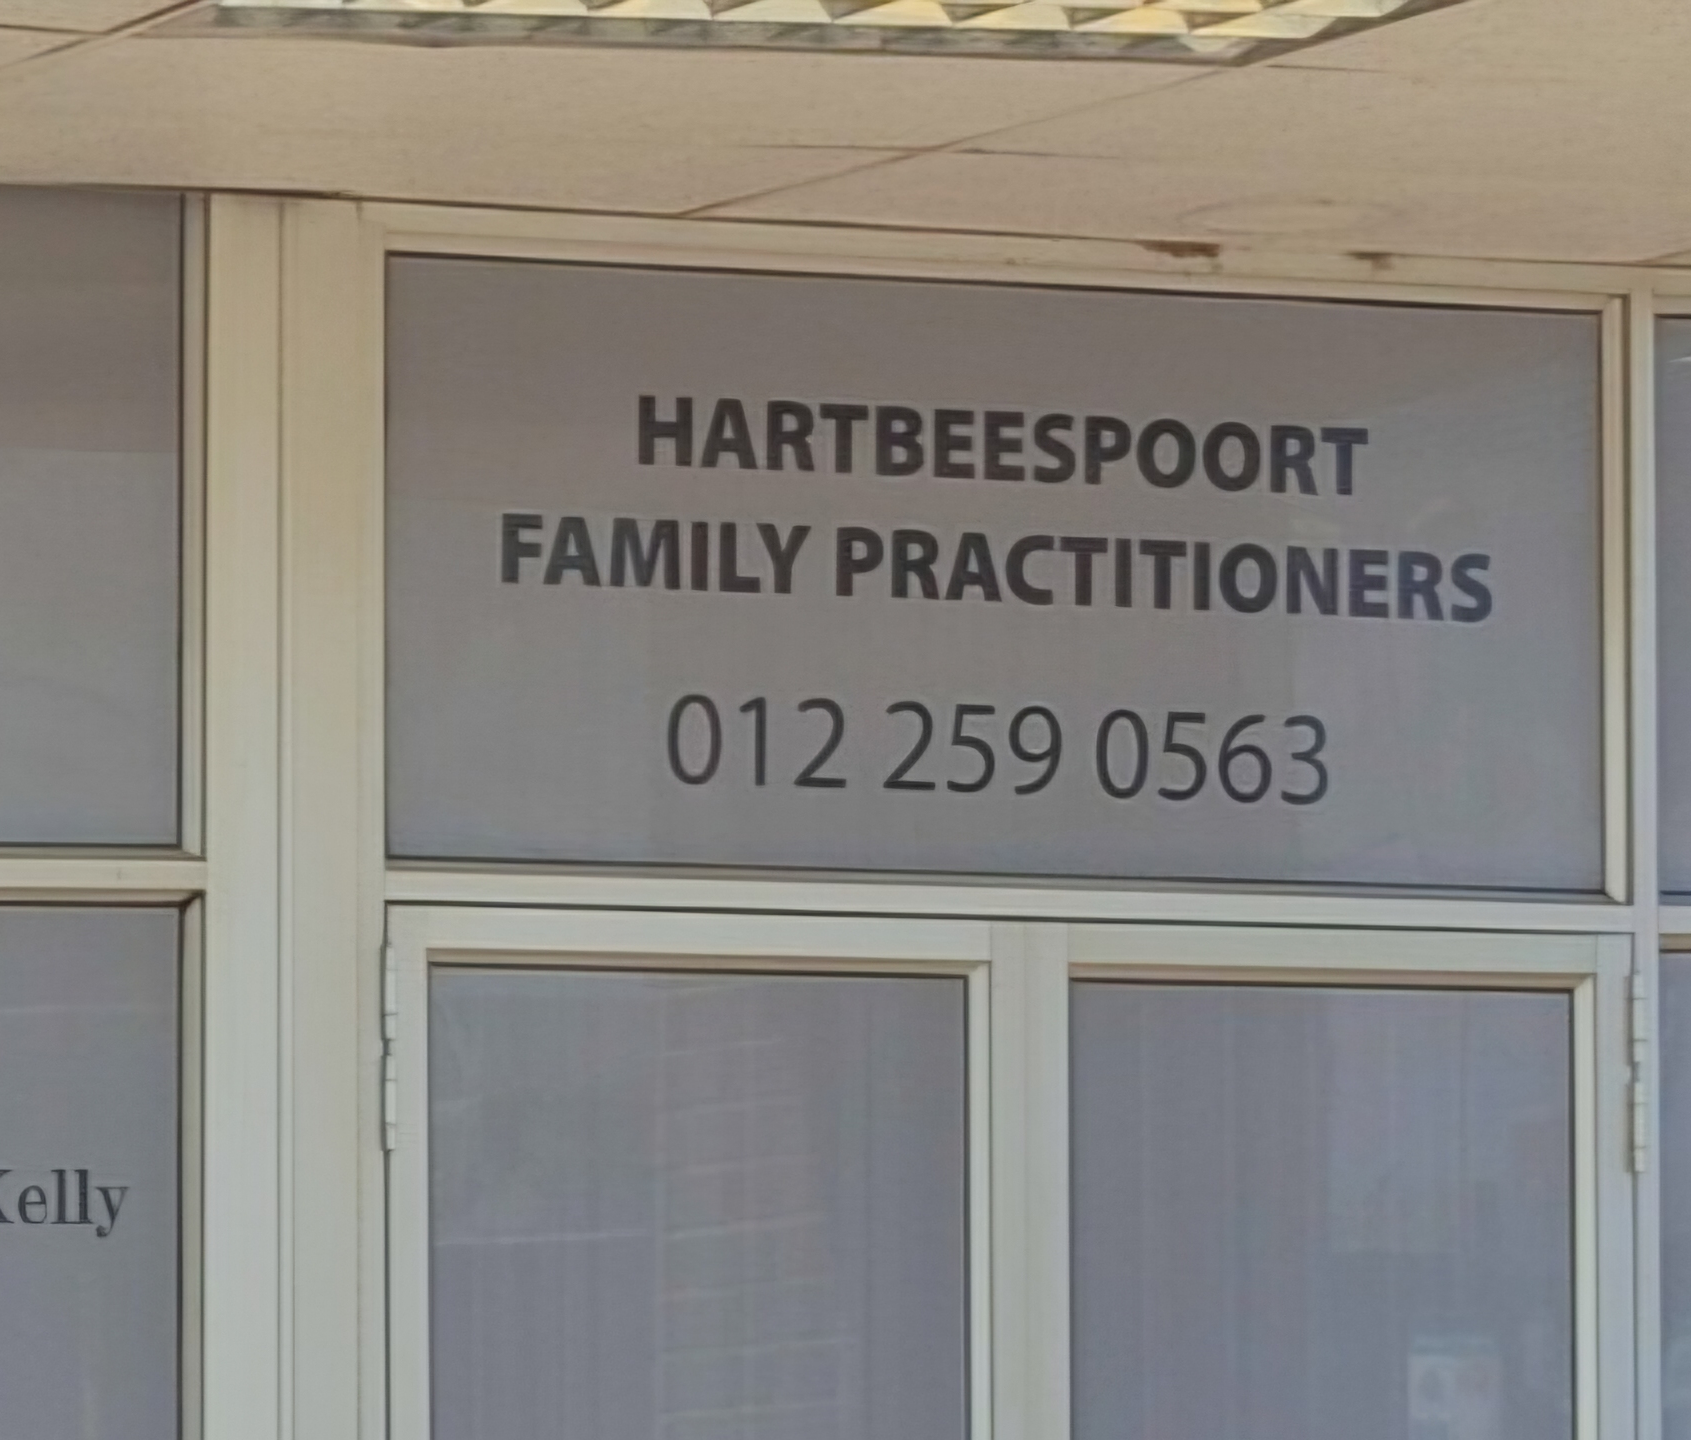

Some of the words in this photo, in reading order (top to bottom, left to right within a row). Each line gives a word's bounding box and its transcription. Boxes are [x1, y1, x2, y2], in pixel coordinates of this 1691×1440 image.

[636, 393, 1369, 497] HARTBEESPOORT
[499, 511, 810, 595] FAMILY
[835, 525, 1495, 624] PRACTITIONERS
[665, 692, 849, 790] 012
[883, 701, 1064, 797] 259
[1095, 707, 1331, 806] 0563
